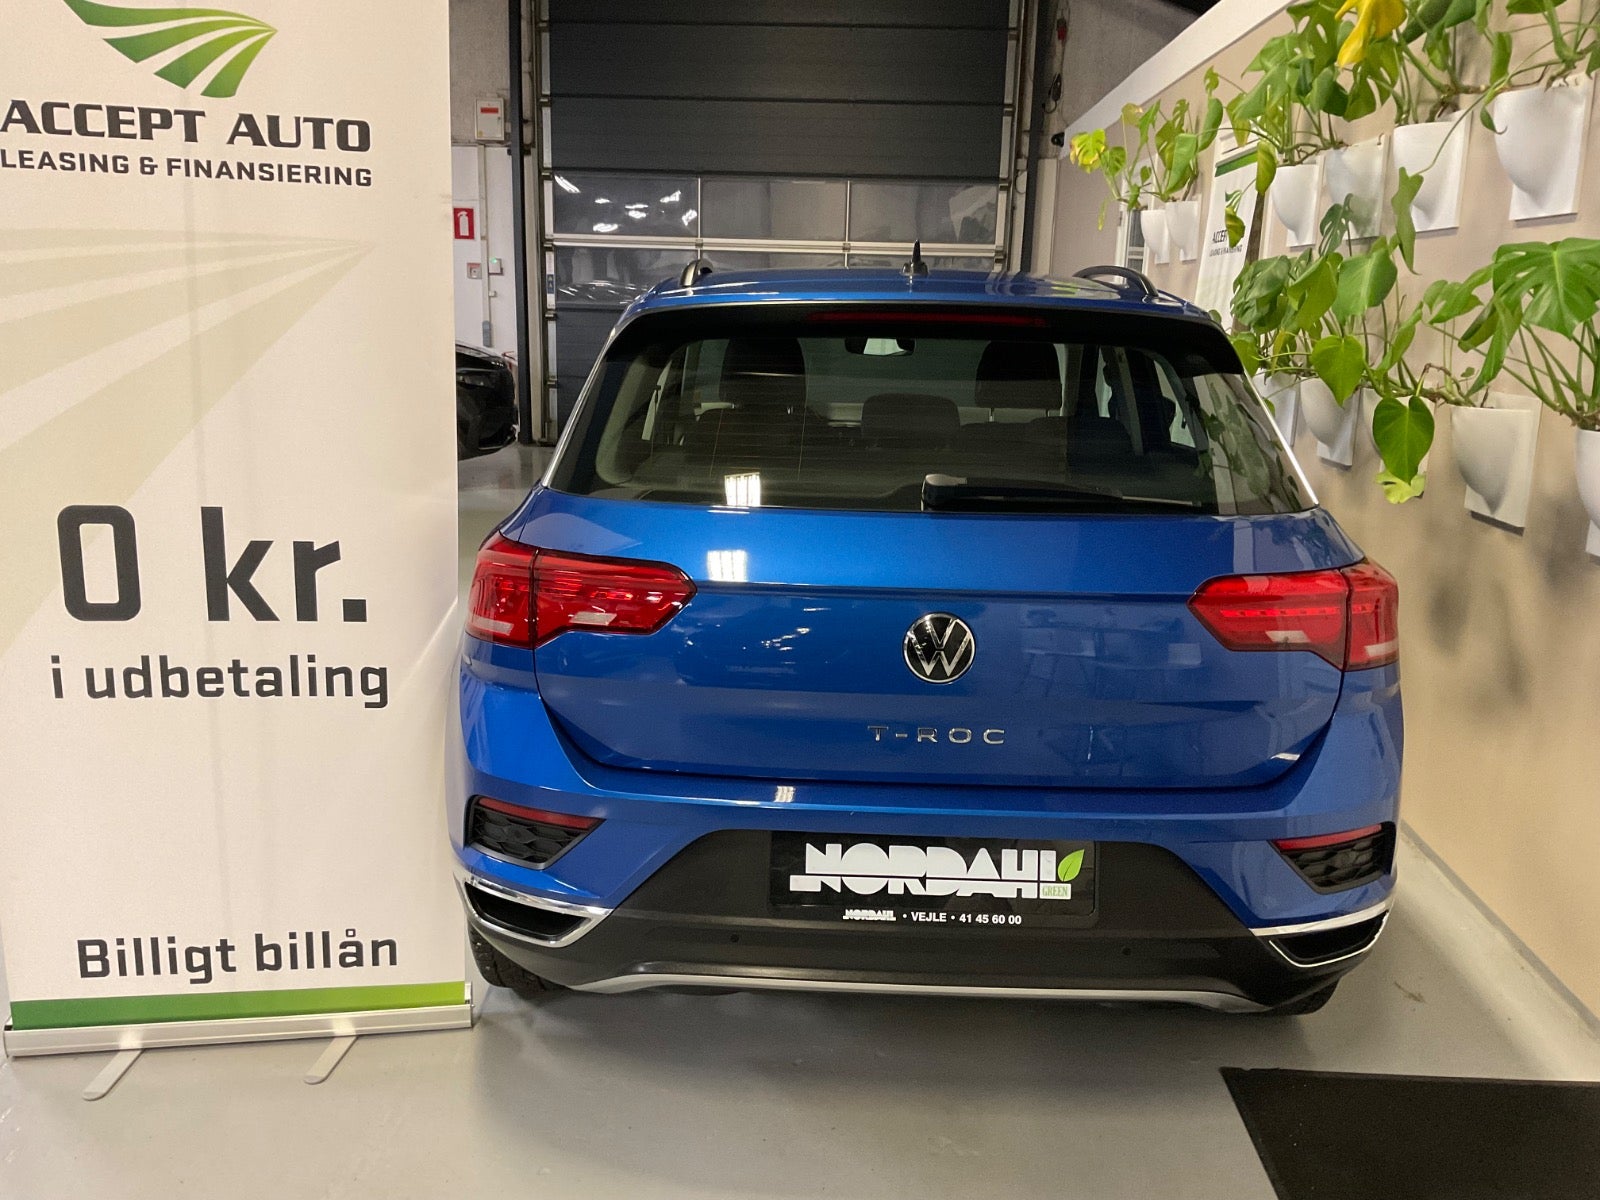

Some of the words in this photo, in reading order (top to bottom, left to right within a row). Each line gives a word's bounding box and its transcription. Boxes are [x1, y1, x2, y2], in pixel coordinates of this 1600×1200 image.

[0, 100, 205, 142] ACCEPT
[227, 113, 370, 152] AUTO
[0, 149, 130, 174] LEASING
[140, 157, 158, 175] &
[167, 158, 371, 186] FINANSIERING
[201, 507, 367, 622] kr.
[51, 655, 63, 698] i
[86, 655, 388, 708] udbetaling
[867, 725, 1005, 744] T-ROC
[1042, 886, 1068, 897] GREEN
[911, 912, 946, 922] VEJLE
[958, 913, 972, 924] 41
[975, 913, 990, 924] 45
[991, 914, 1006, 925] 60
[1008, 914, 1022, 925] 00
[78, 936, 236, 984] Billigt
[255, 929, 397, 971] billån
